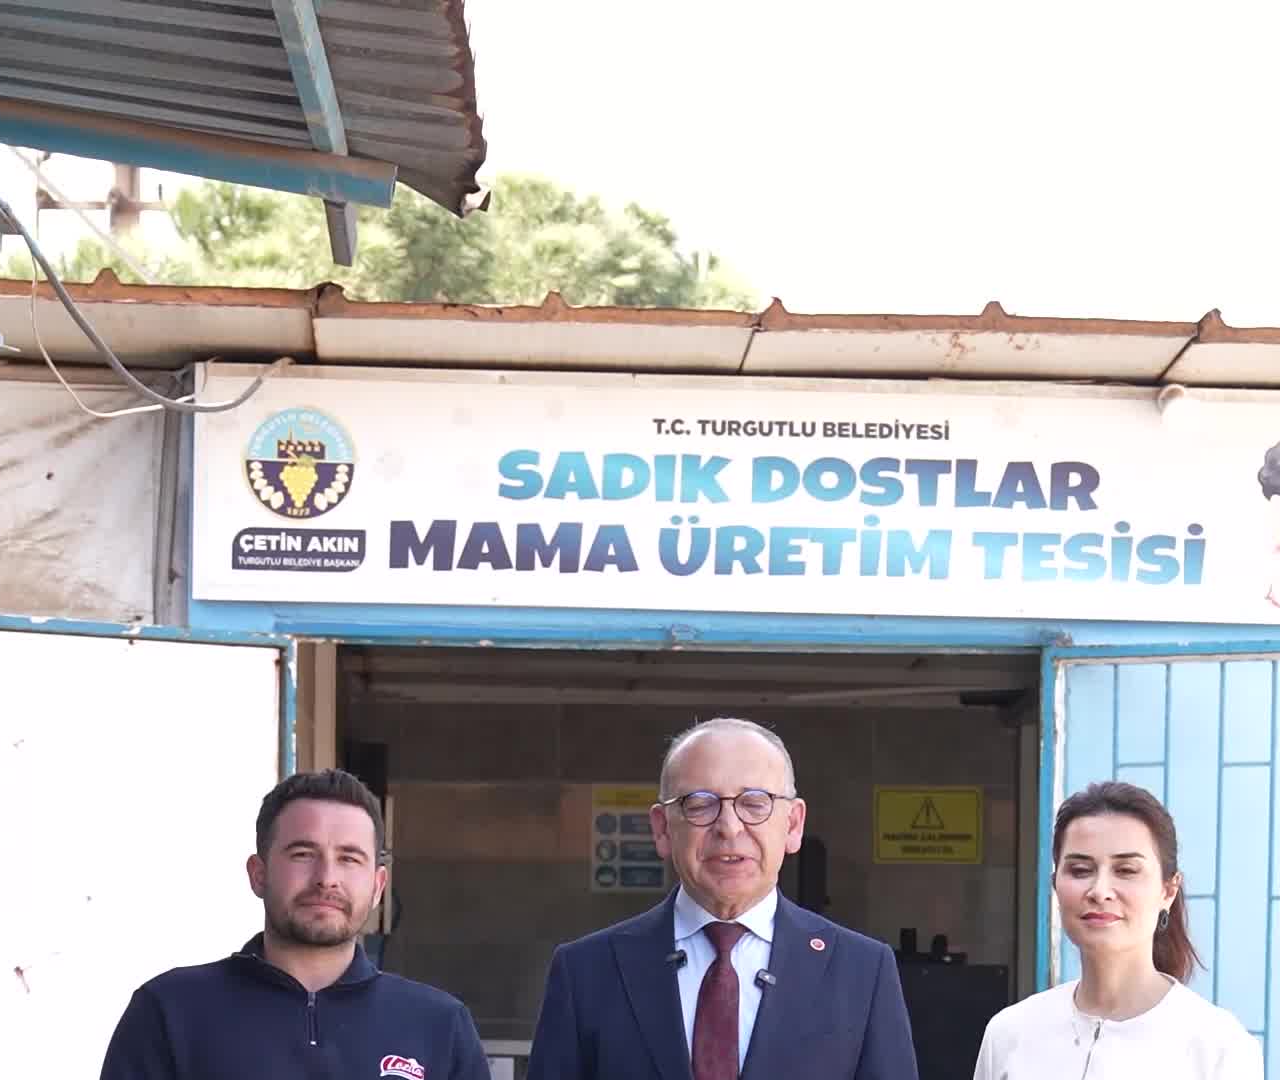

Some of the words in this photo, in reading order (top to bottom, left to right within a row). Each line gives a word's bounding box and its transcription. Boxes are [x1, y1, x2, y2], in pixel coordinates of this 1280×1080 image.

[653, 419, 691, 437] T.C.
[697, 419, 816, 438] TURGUTLU
[822, 419, 950, 441] BELEDİYESİ
[497, 449, 731, 504] SADIK
[752, 455, 1101, 511] DOSTLAR
[239, 532, 302, 553] ÇETİN
[306, 536, 359, 553] AKIN
[389, 519, 639, 574] MAMA
[658, 515, 952, 580] ÜRETİM
[972, 521, 1206, 585] TESİSİ
[238, 556, 282, 566] TURGUTLU
